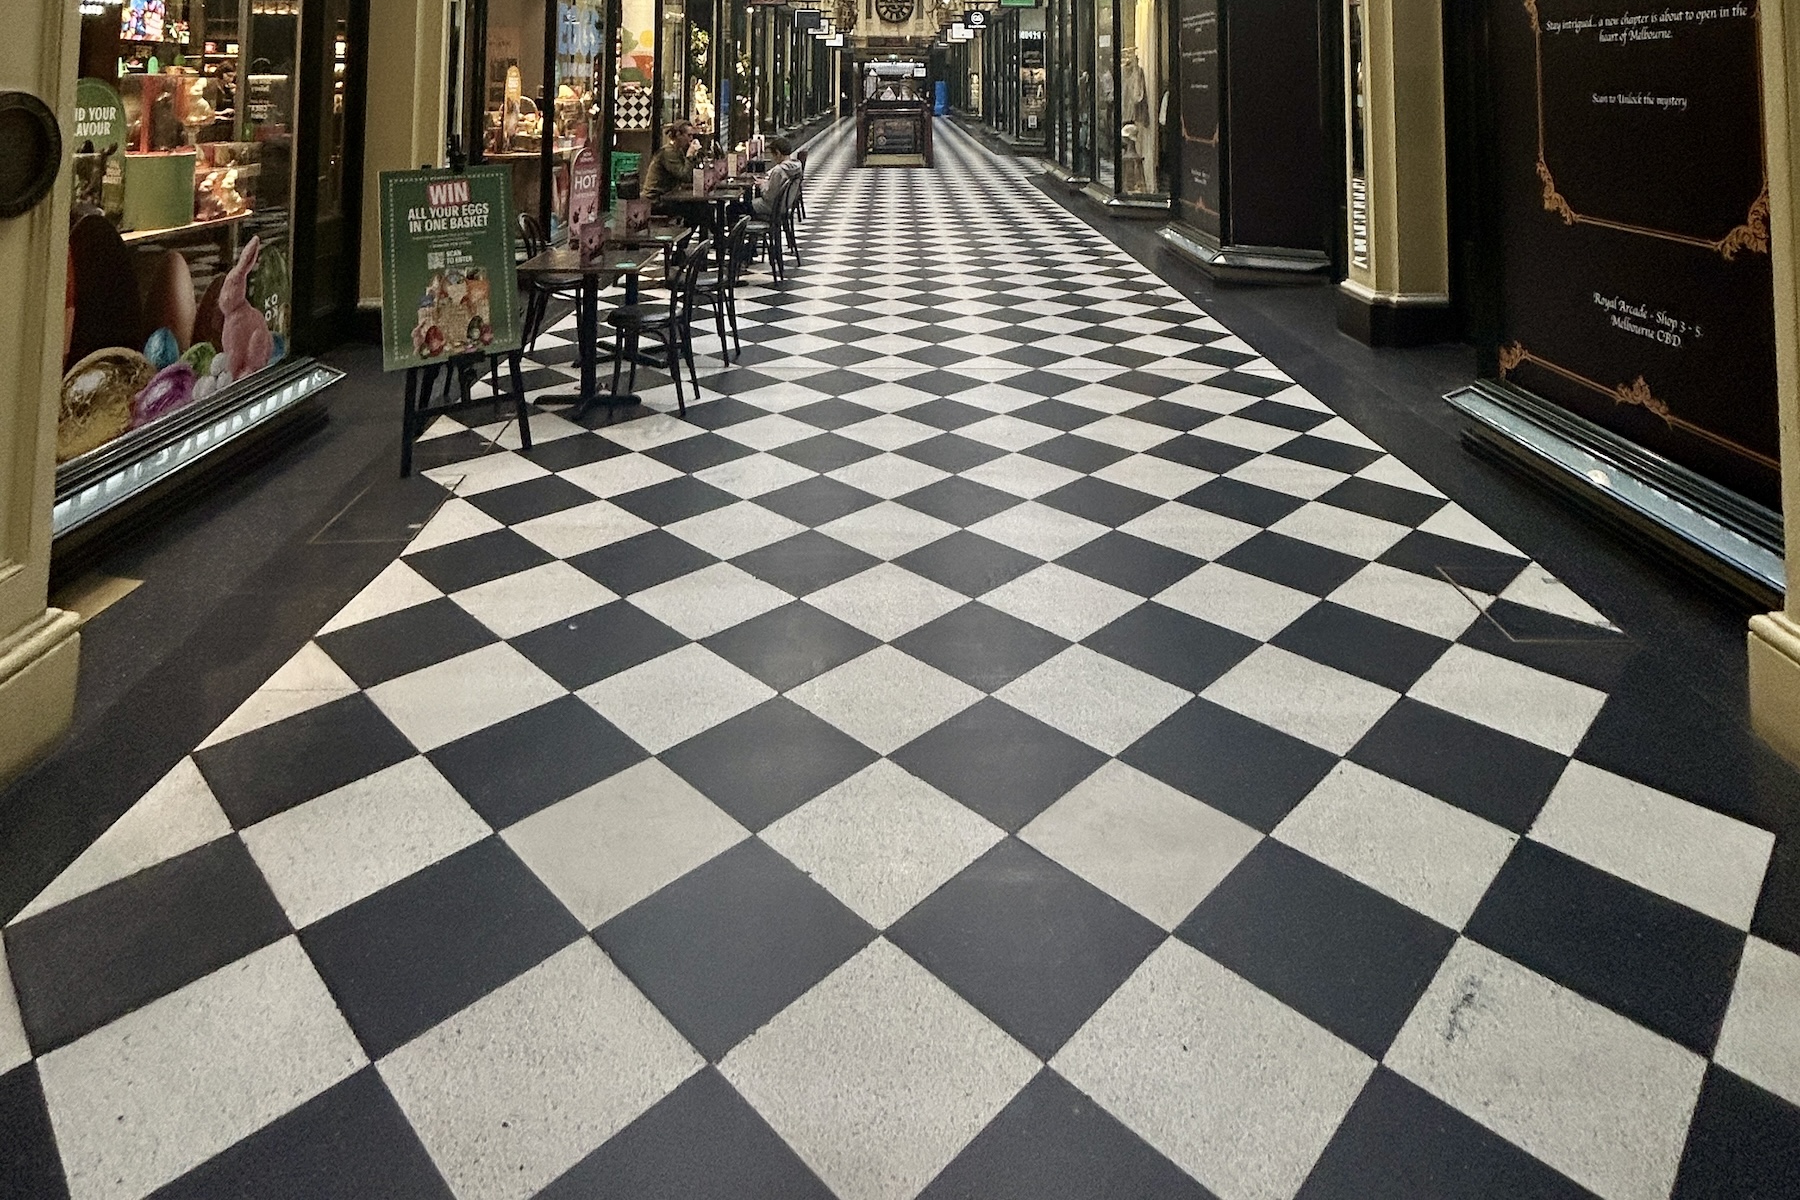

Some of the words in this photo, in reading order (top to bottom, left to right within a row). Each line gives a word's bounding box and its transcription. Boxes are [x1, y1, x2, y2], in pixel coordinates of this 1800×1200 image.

[1598, 19, 1603, 27] a
[1620, 11, 1649, 29] chapter
[1651, 12, 1657, 23] is
[1660, 7, 1684, 22] about
[1685, 11, 1694, 21] to
[1696, 9, 1717, 25] open
[1719, 6, 1729, 18] in
[1732, 1, 1748, 16] the
[1619, 27, 1629, 46] of
[1643, 92, 1654, 104] the
[89, 106, 117, 121] YOUR
[74, 121, 111, 137] AVOUR
[574, 174, 597, 190] HOT
[429, 181, 469, 206] WIN
[408, 207, 427, 221] ALL
[429, 205, 459, 219] YOUR
[462, 203, 489, 217] EGGS
[409, 220, 422, 233] IN
[424, 219, 448, 231] ONE
[450, 215, 489, 230] BASKET
[1593, 292, 1619, 312] Royal
[1618, 300, 1647, 319] Arcade
[1656, 310, 1678, 333] Shop
[1679, 321, 1686, 333] 3
